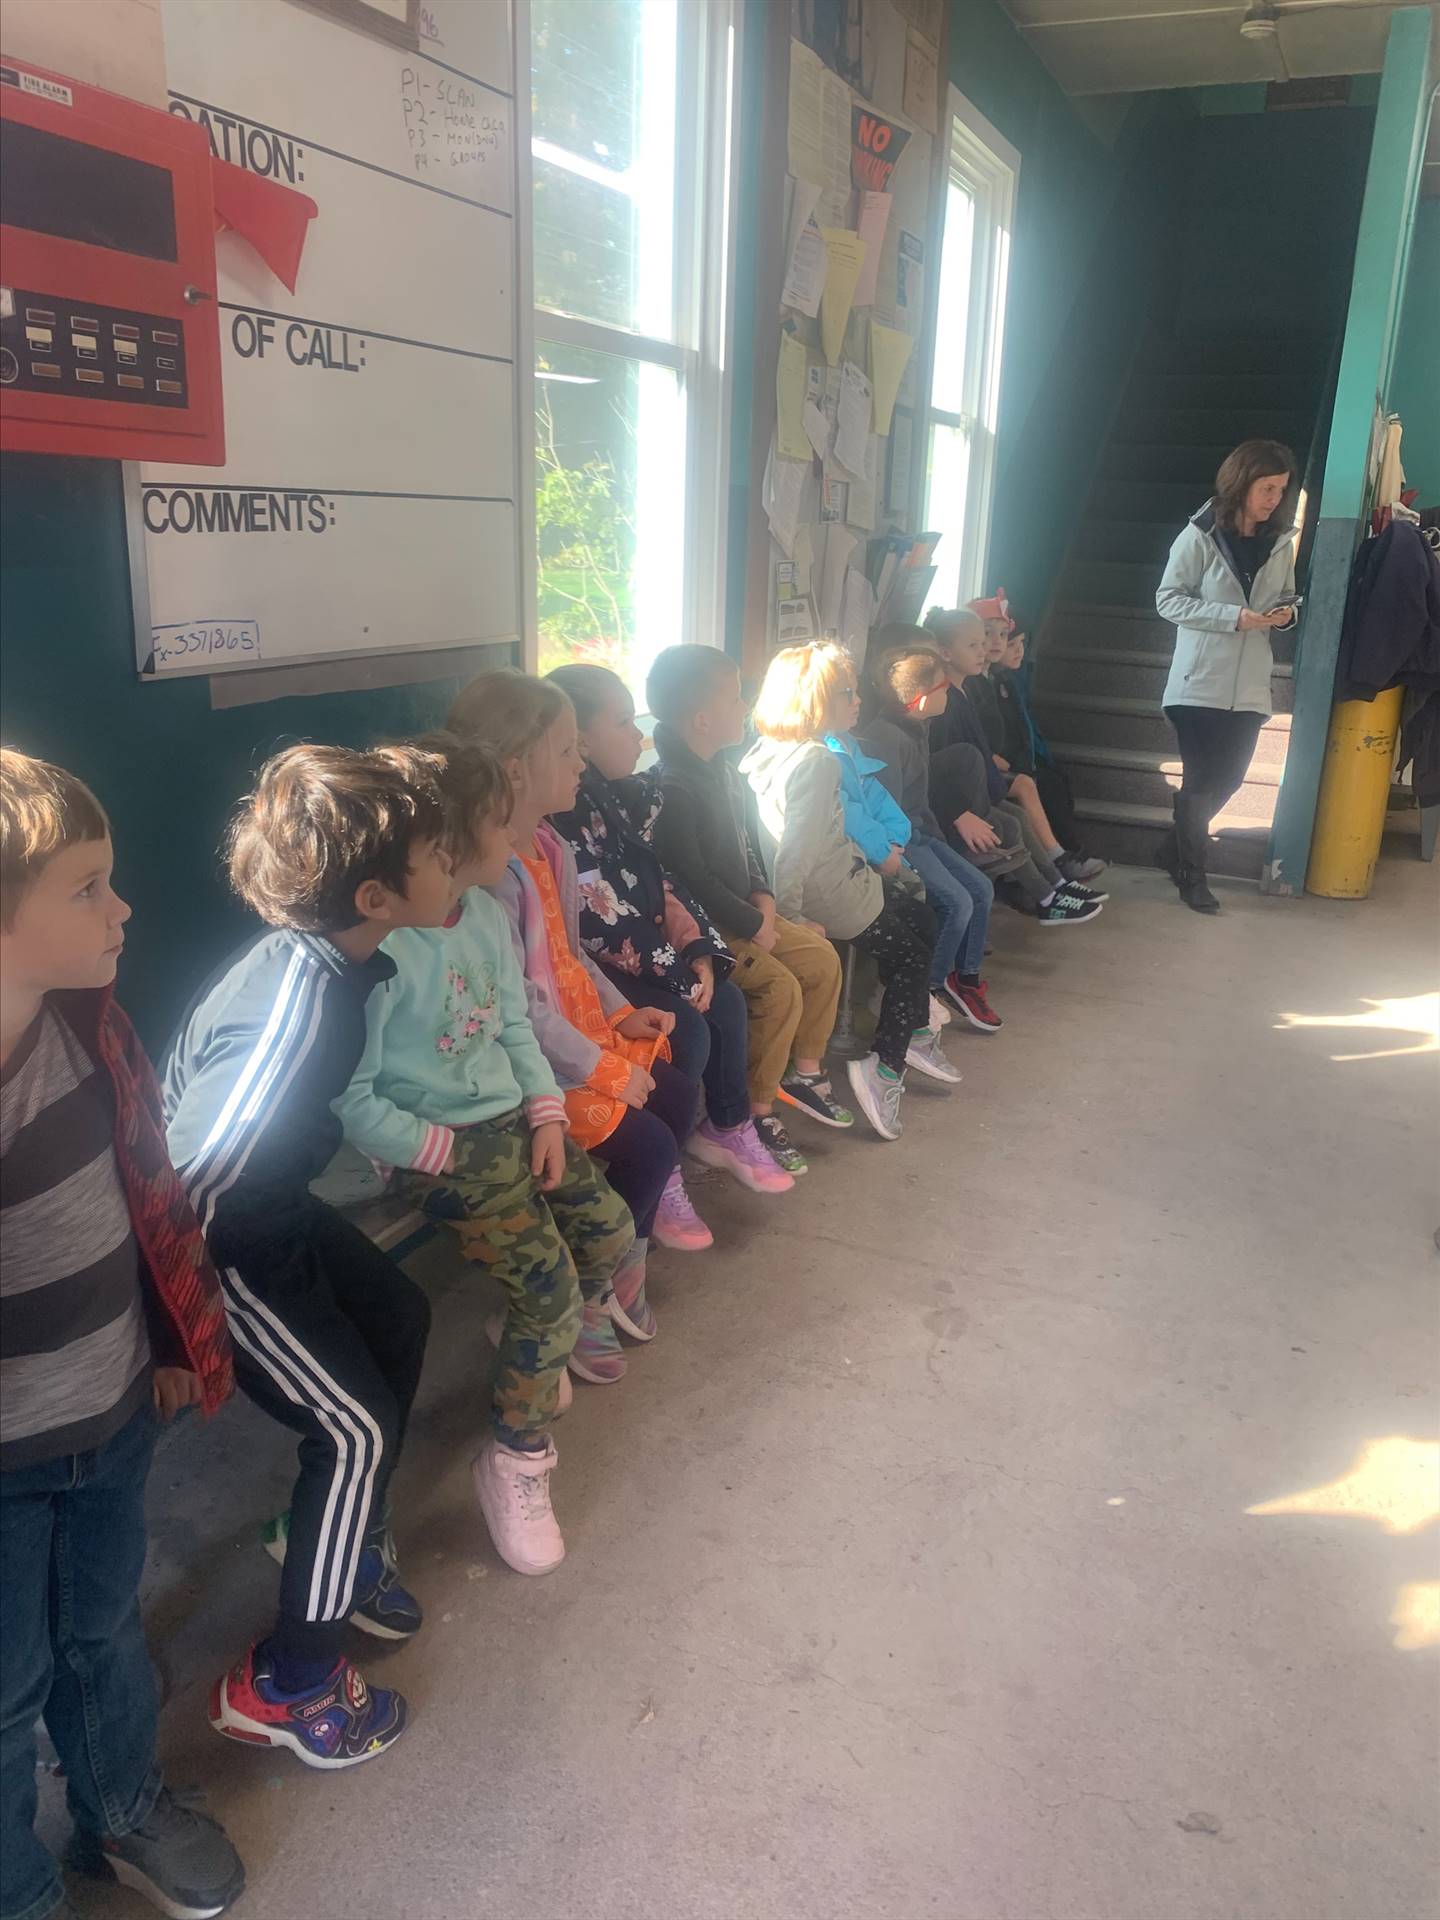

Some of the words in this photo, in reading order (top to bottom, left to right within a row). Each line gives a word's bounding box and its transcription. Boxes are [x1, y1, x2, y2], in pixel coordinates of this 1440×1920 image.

[858, 115, 892, 153] NO
[232, 313, 275, 358] OF
[286, 323, 366, 372] CALL:
[143, 489, 336, 534] COMMENTS:
[303, 1694, 336, 1718] MARIO
